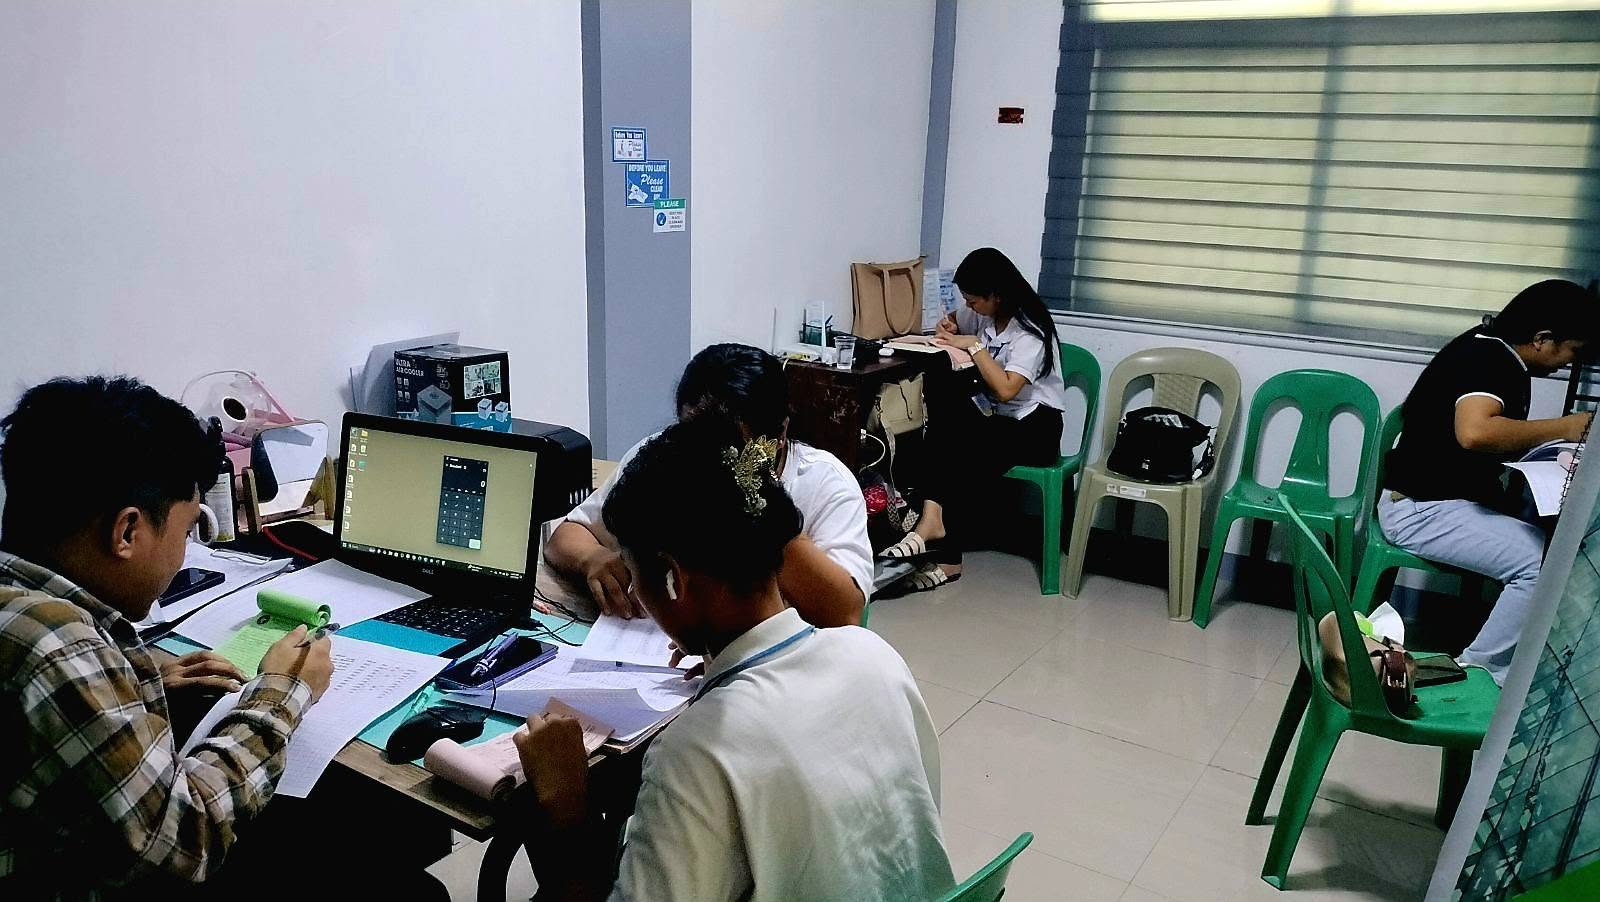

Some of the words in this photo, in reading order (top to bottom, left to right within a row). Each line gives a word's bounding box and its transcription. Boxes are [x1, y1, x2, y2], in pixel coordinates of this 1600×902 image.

[628, 164, 645, 172] BEFORE
[645, 164, 653, 172] YOU
[640, 173, 664, 186] Please
[660, 200, 680, 208] PLEASE
[396, 358, 411, 368] ULTRA
[403, 367, 425, 377] COOLER
